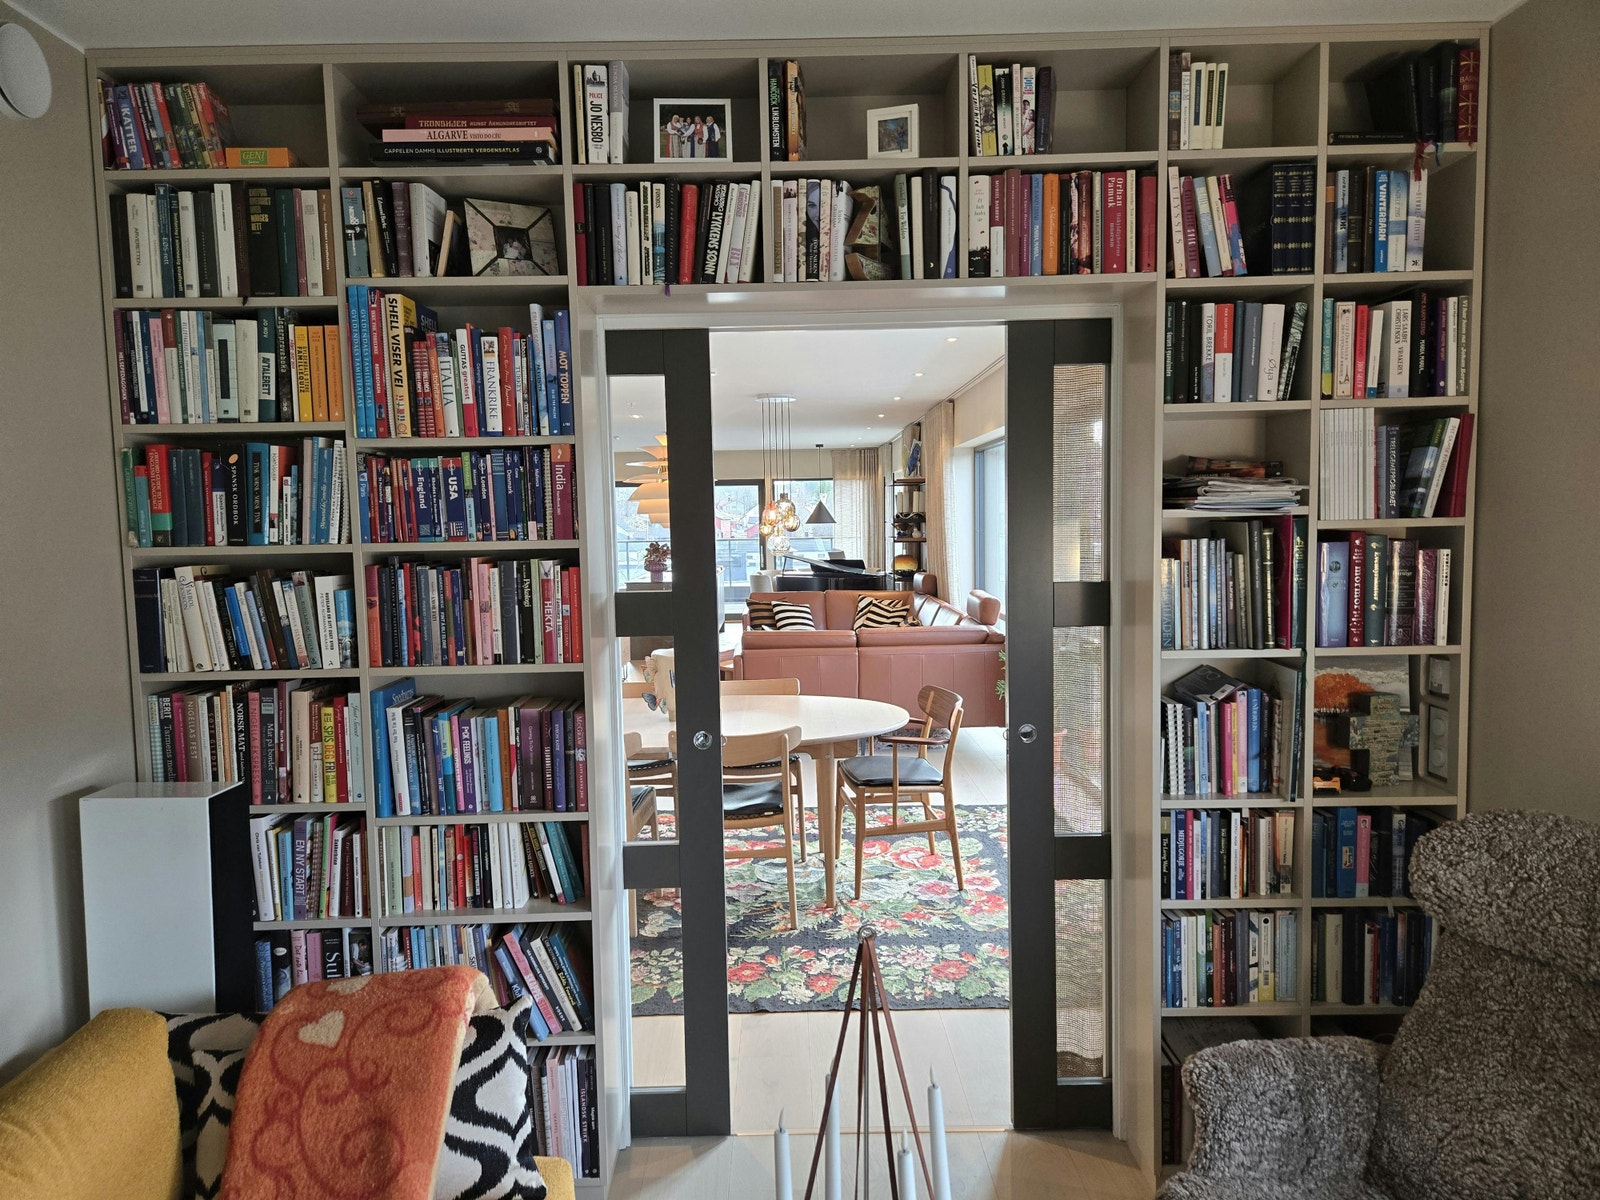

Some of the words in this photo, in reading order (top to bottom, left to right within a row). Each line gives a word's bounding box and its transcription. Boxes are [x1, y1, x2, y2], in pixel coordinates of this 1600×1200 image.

[590, 101, 601, 113] JO
[769, 78, 779, 106] HANCOCK
[121, 107, 137, 153] KATTER
[427, 130, 468, 140] ALGARVE
[771, 107, 780, 147] LIKBLOMSTEN
[1107, 177, 1115, 208] Pamuk
[1172, 186, 1182, 244] ULYSSES
[1378, 184, 1386, 241] VINTERBARN
[707, 212, 723, 249] LYKKENS
[704, 249, 717, 275] SØNN
[388, 298, 399, 331] SHELL
[1401, 308, 1409, 322] LARS
[351, 309, 359, 356] GYLDENDALS
[360, 309, 368, 355] GYLDENDALS
[391, 334, 401, 366] VISER
[558, 350, 568, 370] MOT
[262, 357, 270, 395] AVTALERETT
[353, 358, 363, 407] FAMILIEATLAS
[363, 358, 372, 407] FAMILIEATLAS
[394, 370, 403, 388] VEI
[440, 360, 454, 407] ITALIA
[1264, 358, 1277, 381] Øya
[432, 373, 441, 410] storbritannia
[461, 371, 470, 400] greatest
[486, 361, 498, 420] FRANKRIKE
[560, 372, 570, 404] TOPPEN
[417, 477, 426, 508] England
[448, 477, 458, 500] USA
[555, 465, 565, 490] India
[522, 578, 531, 607] Psykologi
[1354, 566, 1362, 609] mormor
[544, 601, 553, 632] HEKTA
[1162, 604, 1172, 647] ILIADEN
[163, 698, 171, 719] BERIT
[236, 703, 244, 731] NORSK
[164, 725, 172, 758] Tarmens
[266, 739, 273, 747] på
[324, 725, 334, 743] SPIS
[267, 749, 275, 771] bordet
[324, 745, 334, 759] DEG
[463, 741, 471, 764] FEELINGS
[326, 762, 335, 773] FRI
[296, 840, 304, 851] EN
[296, 855, 305, 865] NY
[1177, 829, 1185, 867] MEDJUGORJE
[296, 869, 305, 895] START
